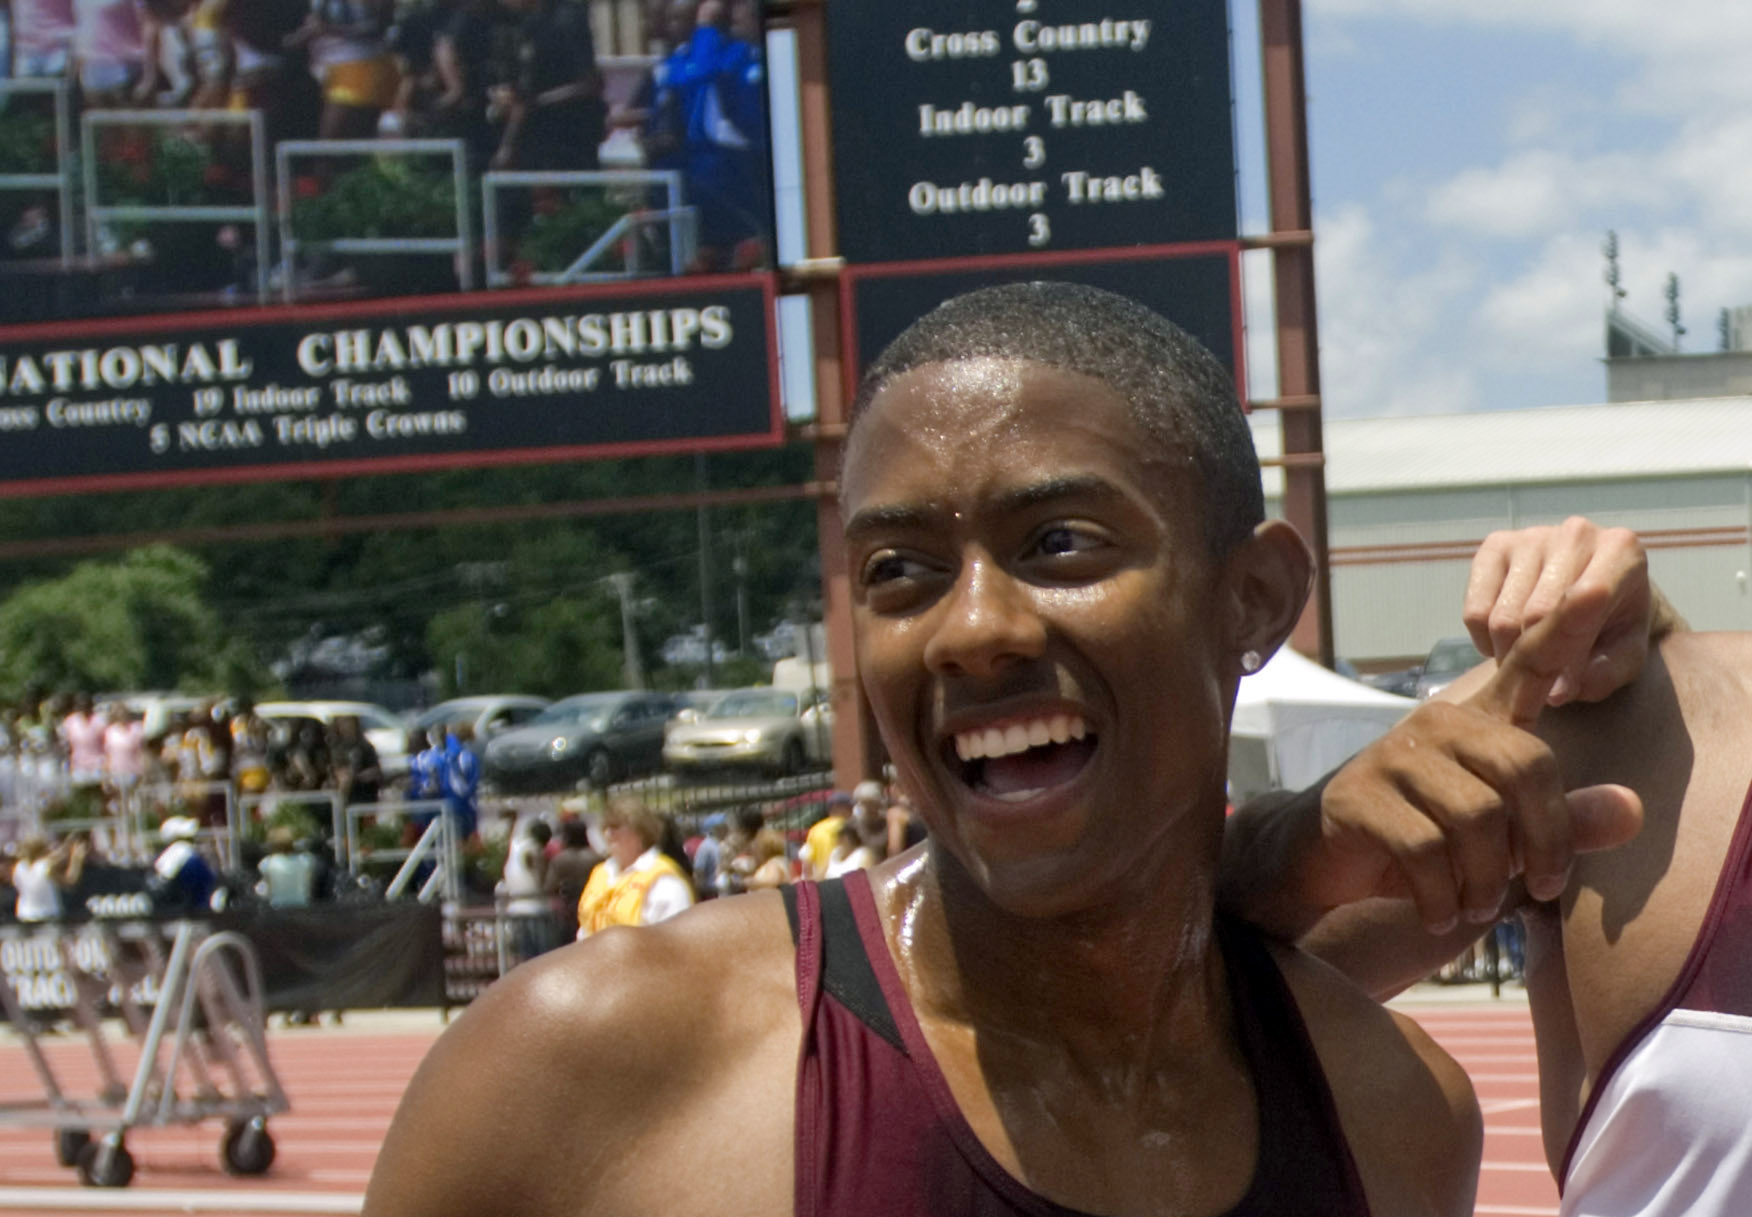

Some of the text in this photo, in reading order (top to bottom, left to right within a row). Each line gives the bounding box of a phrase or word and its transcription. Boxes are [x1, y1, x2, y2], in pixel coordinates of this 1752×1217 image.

[905, 18, 1152, 62] Cross Country
[1011, 58, 1049, 92] 13
[919, 90, 1148, 138] Indoor Track
[1022, 135, 1046, 170] 3
[908, 166, 1165, 216] Outdoor Track
[1027, 212, 1050, 247] 3
[0, 305, 734, 396] ATIONAL CHAMPIONSHIPS
[45, 397, 152, 427] Country
[193, 387, 224, 416] 19
[233, 384, 322, 414] Indoor
[330, 374, 412, 410] Track
[447, 368, 481, 401] 10
[487, 363, 599, 398] Outdoor
[609, 355, 693, 391] Track
[178, 419, 262, 449] NCAA
[273, 412, 357, 448] Triple
[365, 408, 467, 441] Crowns
